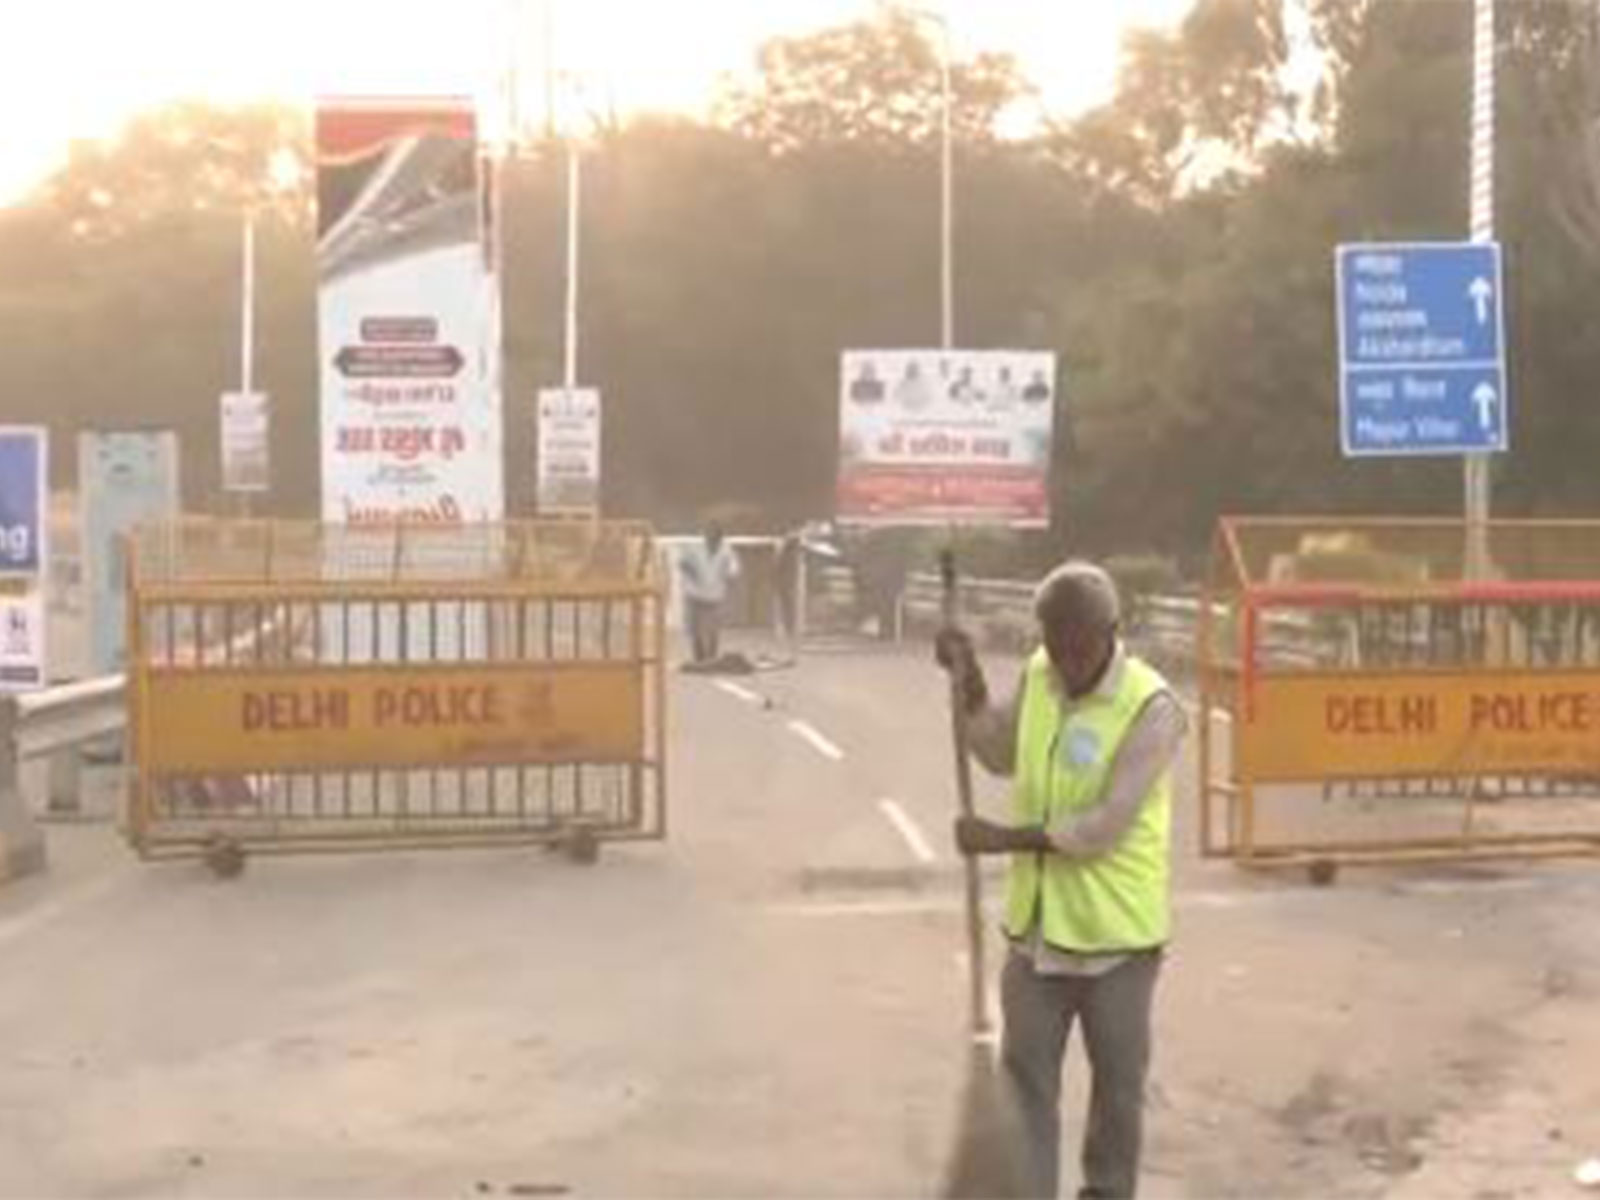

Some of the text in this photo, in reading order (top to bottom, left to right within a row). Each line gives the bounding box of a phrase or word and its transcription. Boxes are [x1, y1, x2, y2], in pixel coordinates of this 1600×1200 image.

[242, 684, 503, 732] DELHI POLICE
[1325, 693, 1589, 734] DELHI POLICE
